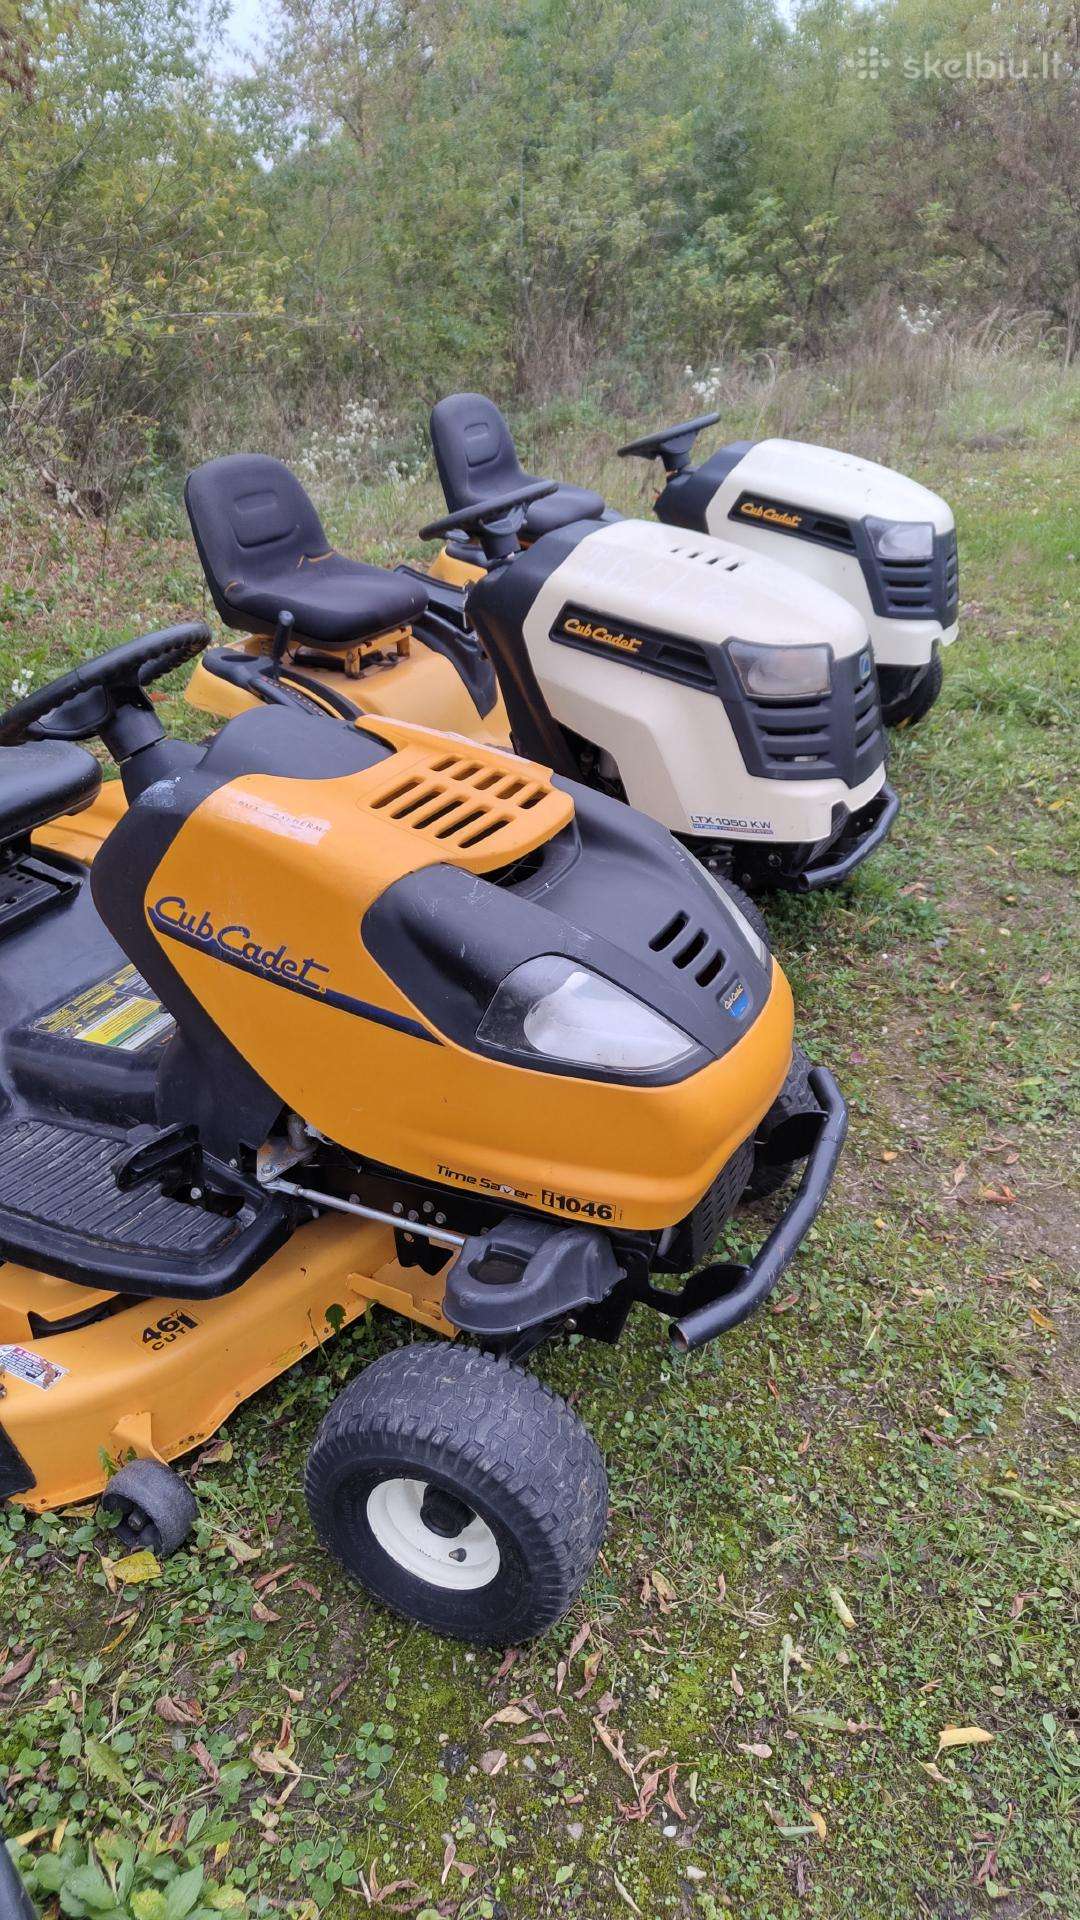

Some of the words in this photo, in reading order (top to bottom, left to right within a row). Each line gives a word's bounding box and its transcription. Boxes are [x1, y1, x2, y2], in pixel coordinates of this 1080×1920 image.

[564, 617, 592, 637] Cub
[592, 627, 642, 653] Cadet
[690, 815, 714, 824] LTX
[715, 817, 748, 828] 1050
[155, 896, 214, 942] Cub
[217, 925, 330, 991] Cadet
[437, 1164, 477, 1185] Time
[479, 1177, 534, 1199] Saver
[152, 1326, 186, 1350] CUT
